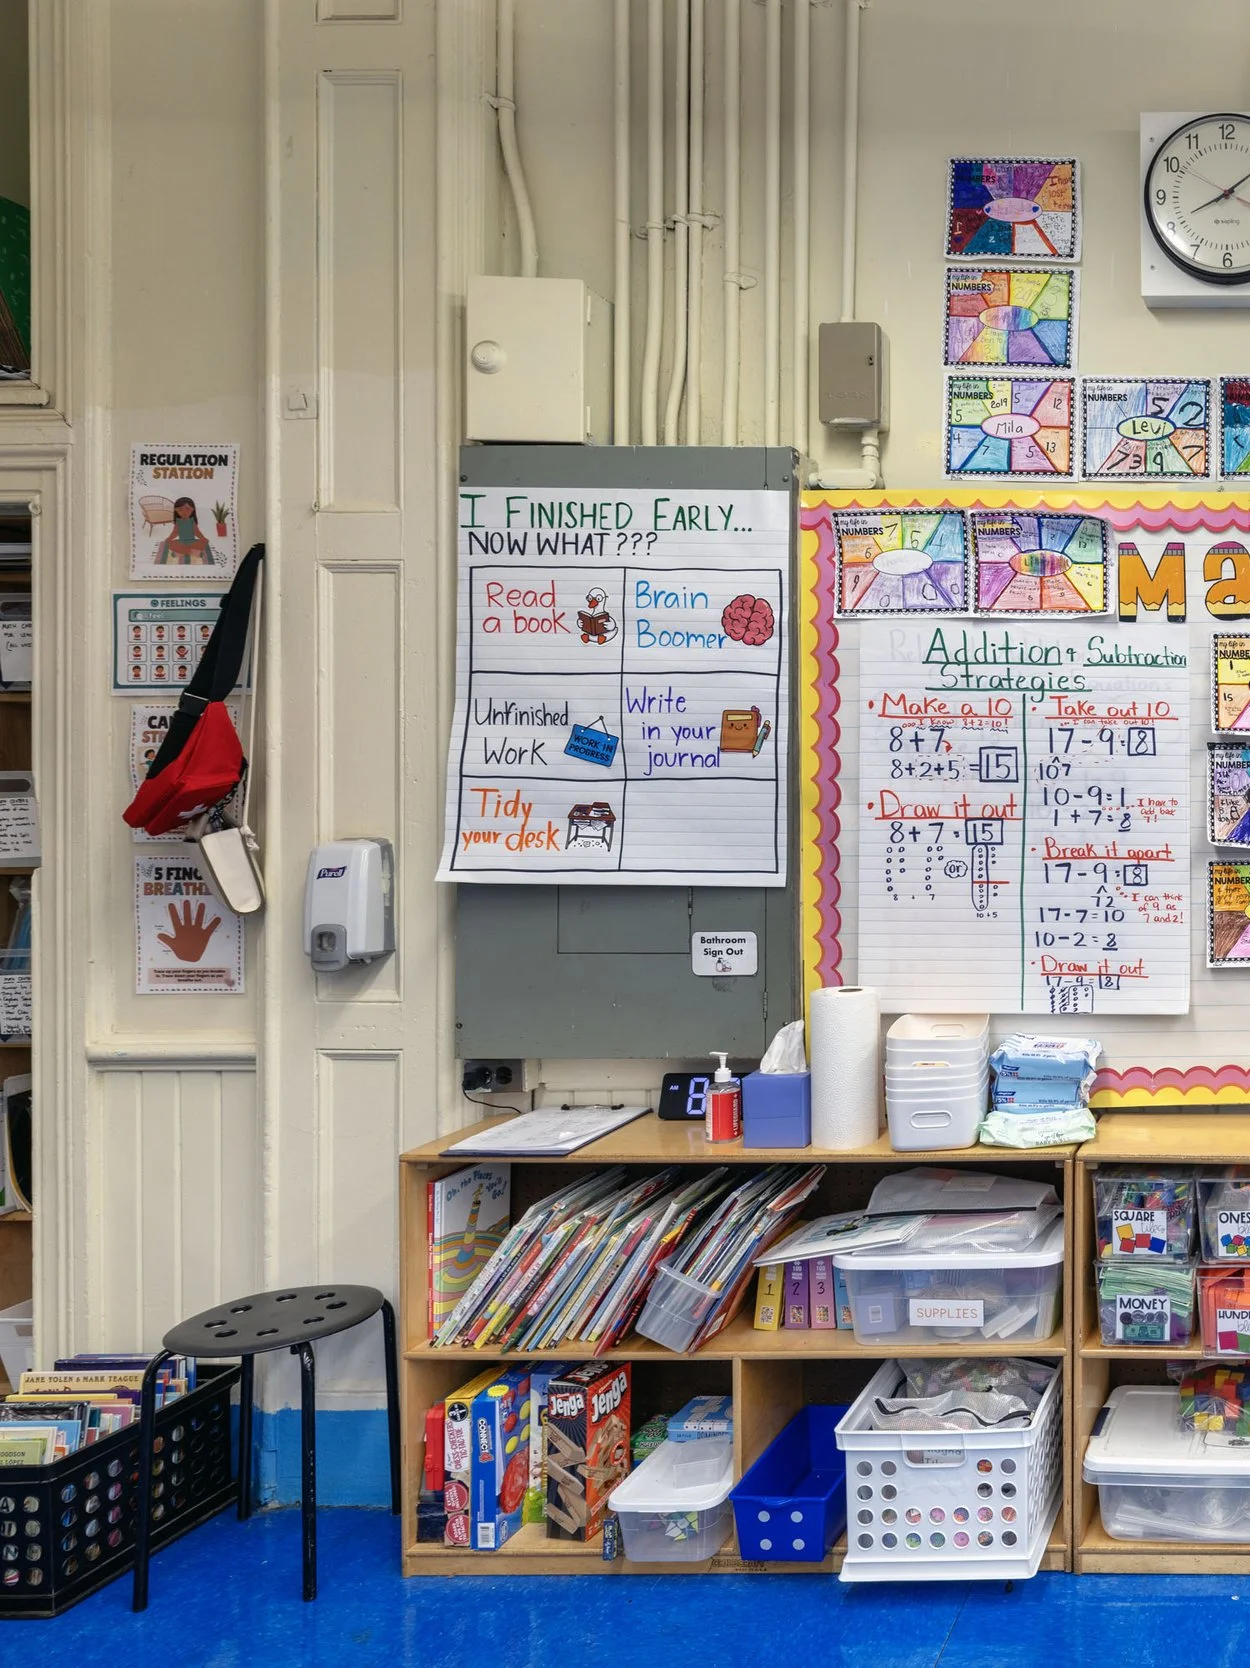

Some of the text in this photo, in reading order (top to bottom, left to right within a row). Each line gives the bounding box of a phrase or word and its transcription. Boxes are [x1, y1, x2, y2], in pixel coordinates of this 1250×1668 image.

[952, 283, 992, 291] NUMBERS
[995, 422, 1023, 435] Mila
[1132, 420, 1167, 436] Levi
[140, 453, 228, 467] REGULATION
[152, 467, 214, 480] STATION
[460, 494, 486, 528] I
[506, 496, 633, 530] FINISHED
[469, 531, 528, 555] NOW
[537, 532, 611, 556] WHAT
[841, 527, 884, 536] NUMBERS
[978, 527, 1021, 536] NUMBERS
[160, 599, 207, 608] FEELINGS
[486, 580, 557, 608] Read
[636, 580, 708, 609] Brain
[483, 609, 571, 634] a book
[637, 619, 728, 649] Boomer
[925, 627, 1187, 666] Addition Subtraction
[940, 663, 1087, 703] Strategies
[626, 686, 686, 714] Write
[882, 693, 1012, 716] Make a 10
[1049, 695, 1170, 717] Take out 10
[474, 698, 569, 727] Unfinished
[642, 722, 717, 746] in your
[484, 737, 547, 766] Work
[643, 745, 721, 776] journal
[470, 788, 533, 826] Tidy
[879, 789, 1018, 819] Draw it out
[462, 822, 561, 852] your desk
[1044, 836, 1172, 865] Break it apart
[700, 936, 746, 945] Bathroom
[703, 948, 744, 957] Sign Out
[1041, 955, 1145, 975] Draw it out
[1114, 1210, 1155, 1222] SQUARE
[916, 1308, 978, 1320] SUPPLIES
[1119, 1298, 1167, 1310] MONEY
[108, 1375, 139, 1383] TEAGUE
[550, 1393, 585, 1417] Jenga
[591, 1371, 628, 1423] Jenga
